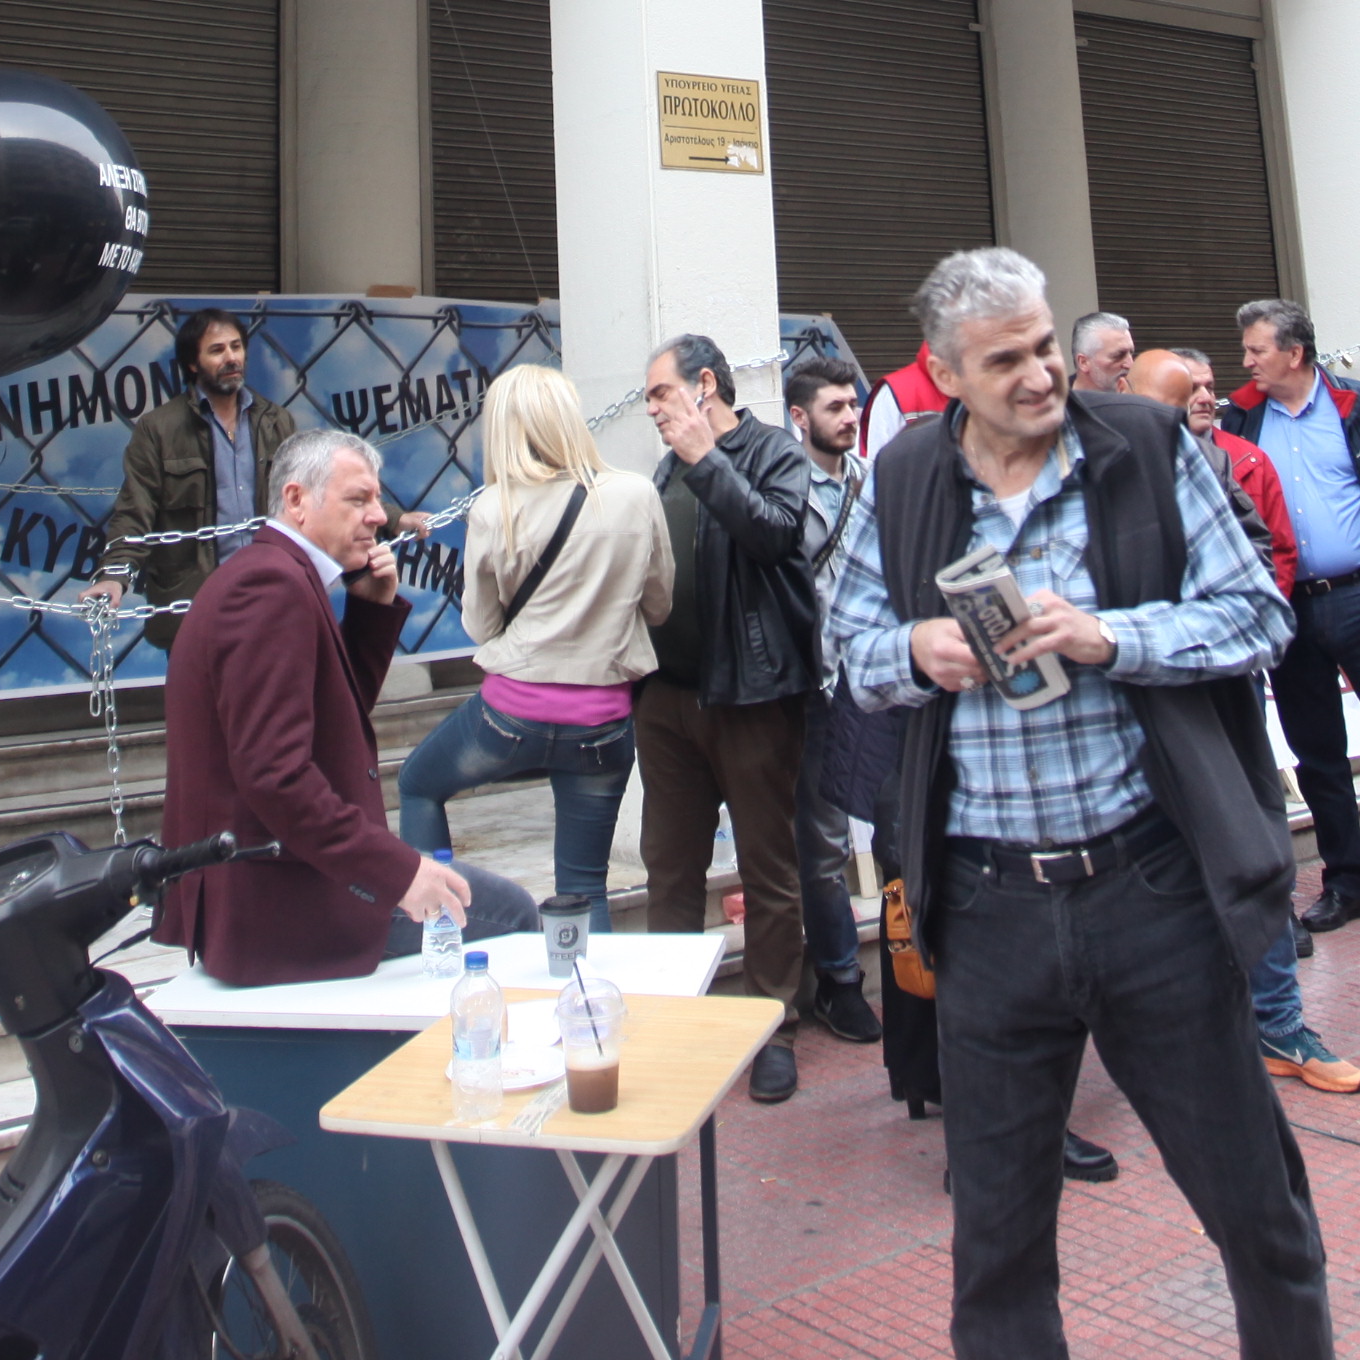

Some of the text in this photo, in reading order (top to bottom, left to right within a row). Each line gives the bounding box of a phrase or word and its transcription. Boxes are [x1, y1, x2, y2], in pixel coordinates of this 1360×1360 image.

[664, 78, 751, 95] ΥΠΟΥΡΓΕΙΟ ΥΓΕΙΑΣ
[663, 95, 756, 122] ΠΡΩΤΟΚΟΛΛΟ
[664, 133, 715, 148] Αριστοτέλους
[717, 137, 725, 147] 19
[99, 163, 132, 191] ΑΛΕΞΗ
[98, 242, 121, 268] ΜΕ
[117, 245, 132, 271] ΤΟ
